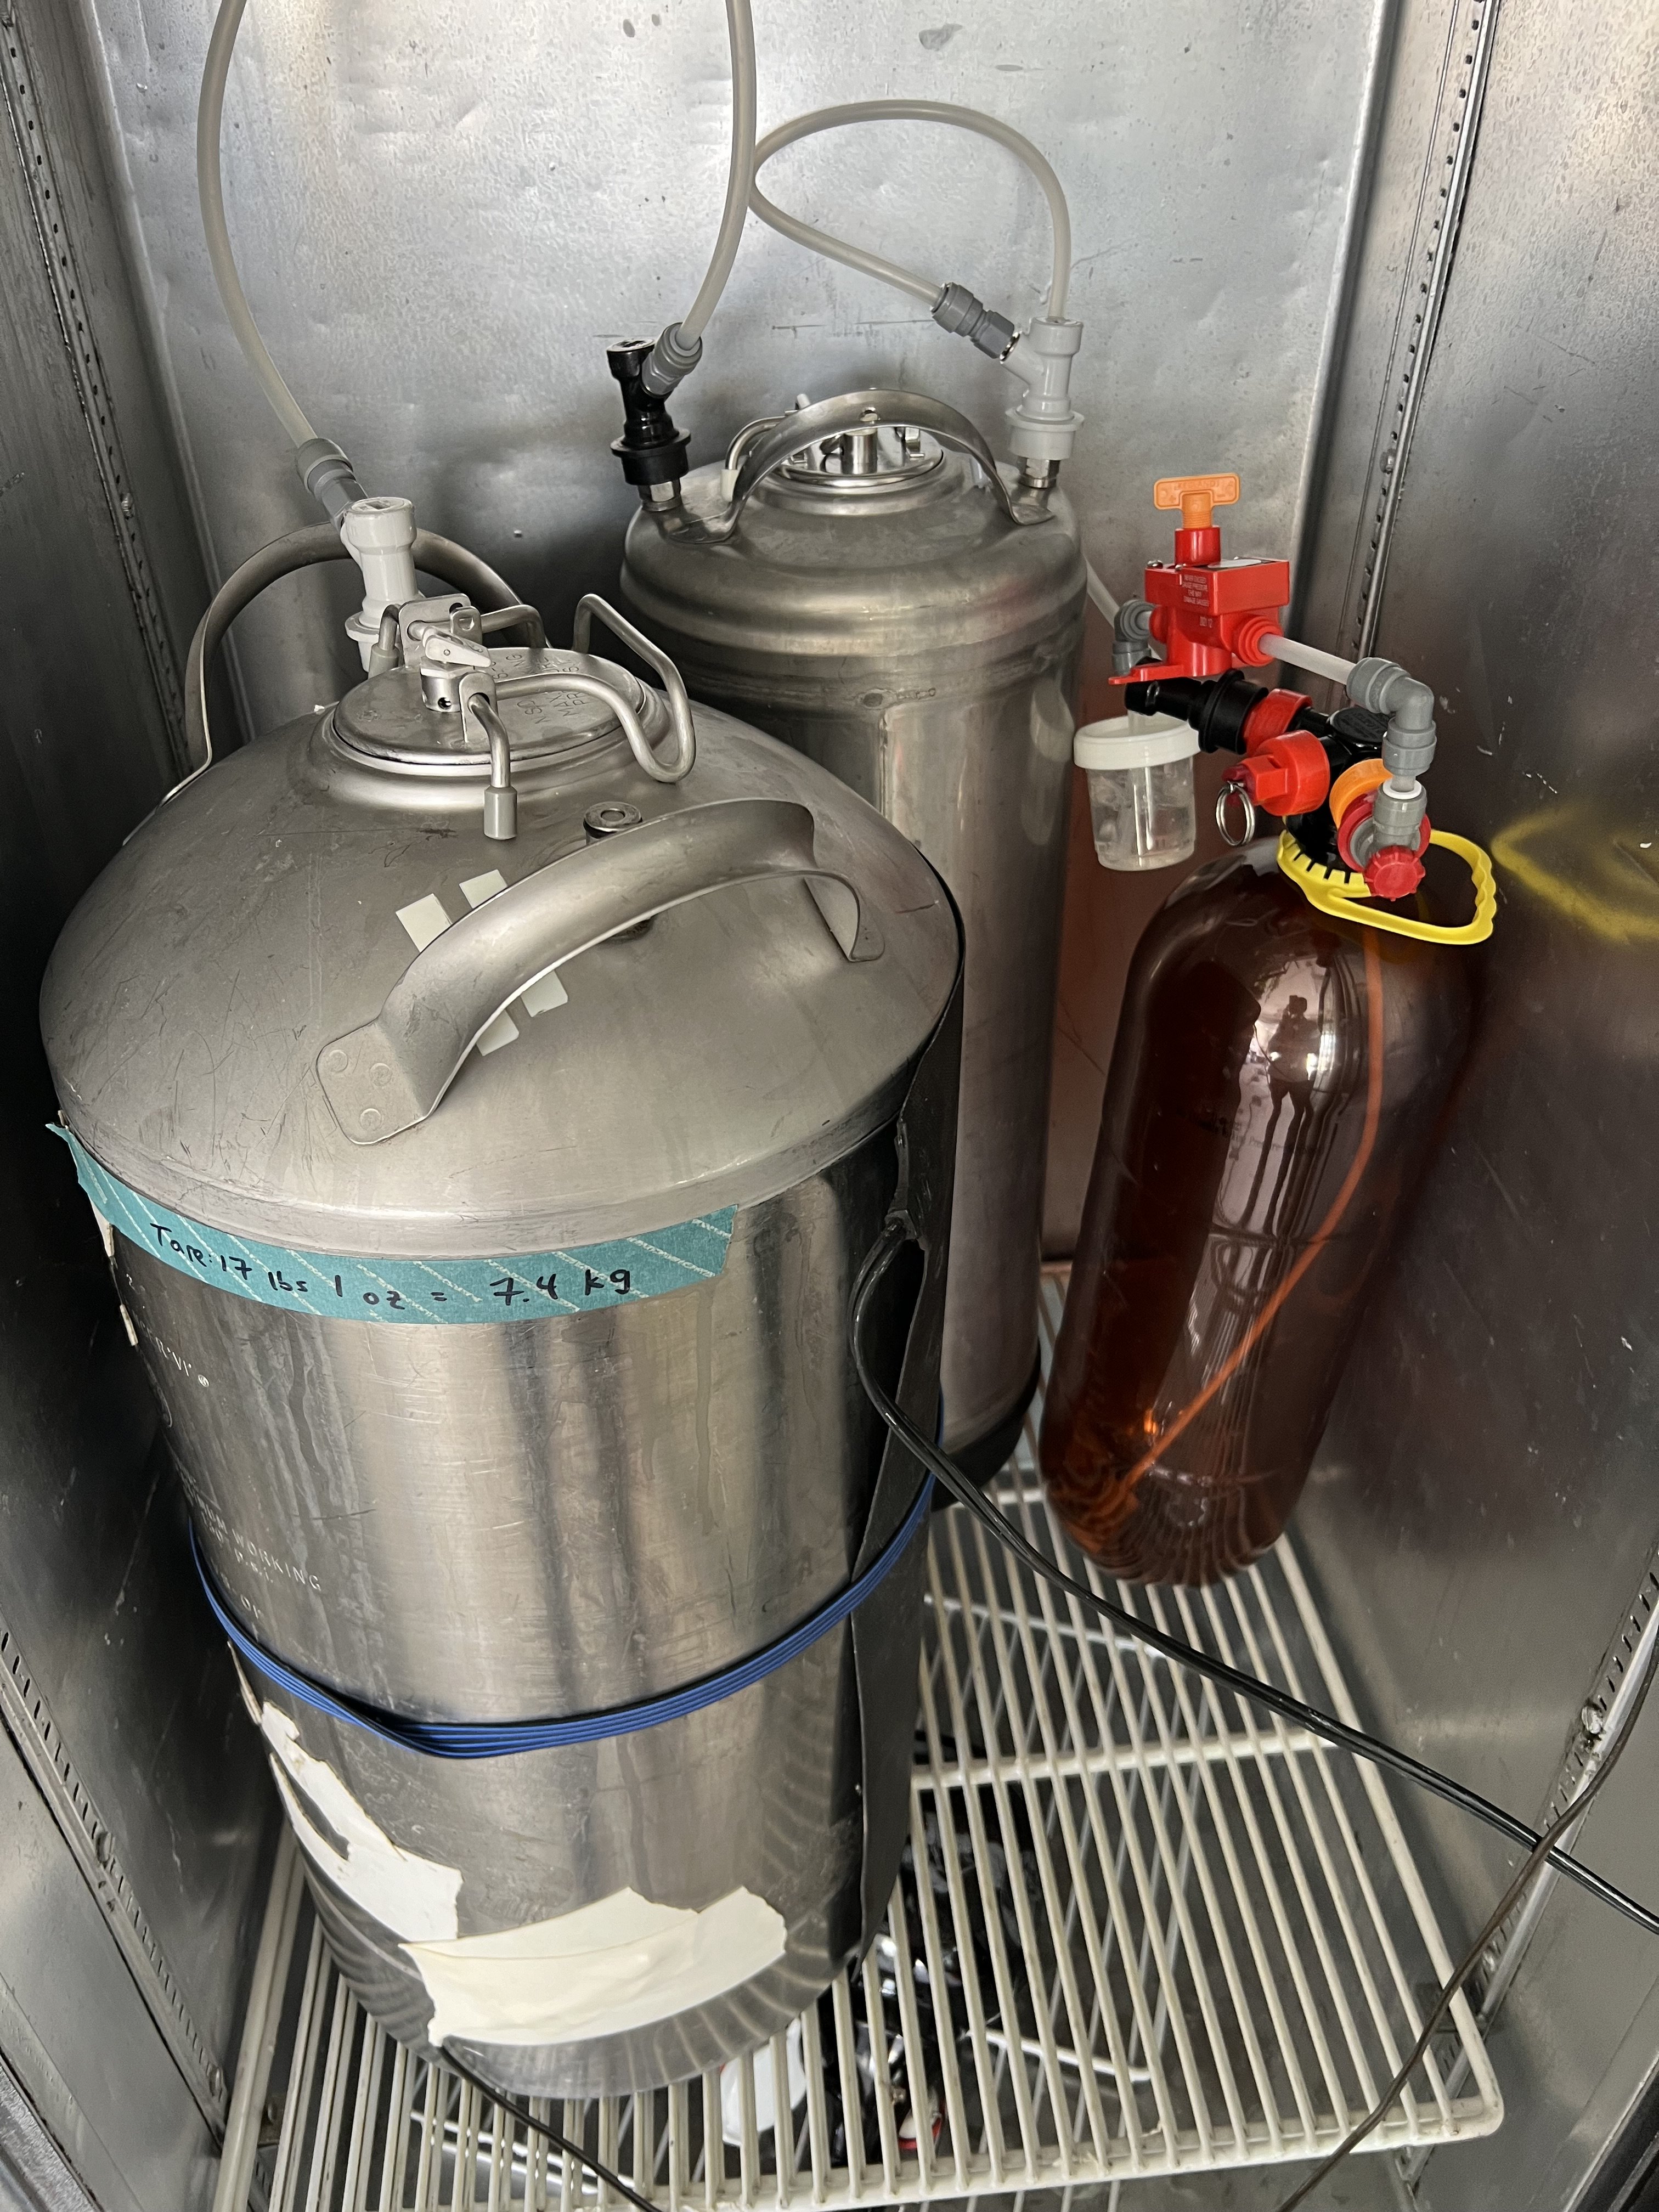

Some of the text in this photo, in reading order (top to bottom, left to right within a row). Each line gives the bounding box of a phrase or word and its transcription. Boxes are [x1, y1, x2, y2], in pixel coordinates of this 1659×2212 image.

[221, 1255, 253, 1280] 17
[268, 1271, 308, 1293] lbs
[363, 1290, 405, 1310] oz
[489, 1273, 558, 1306] 7.4
[585, 1269, 630, 1295] kg
[232, 1528, 321, 1592] WORKING
